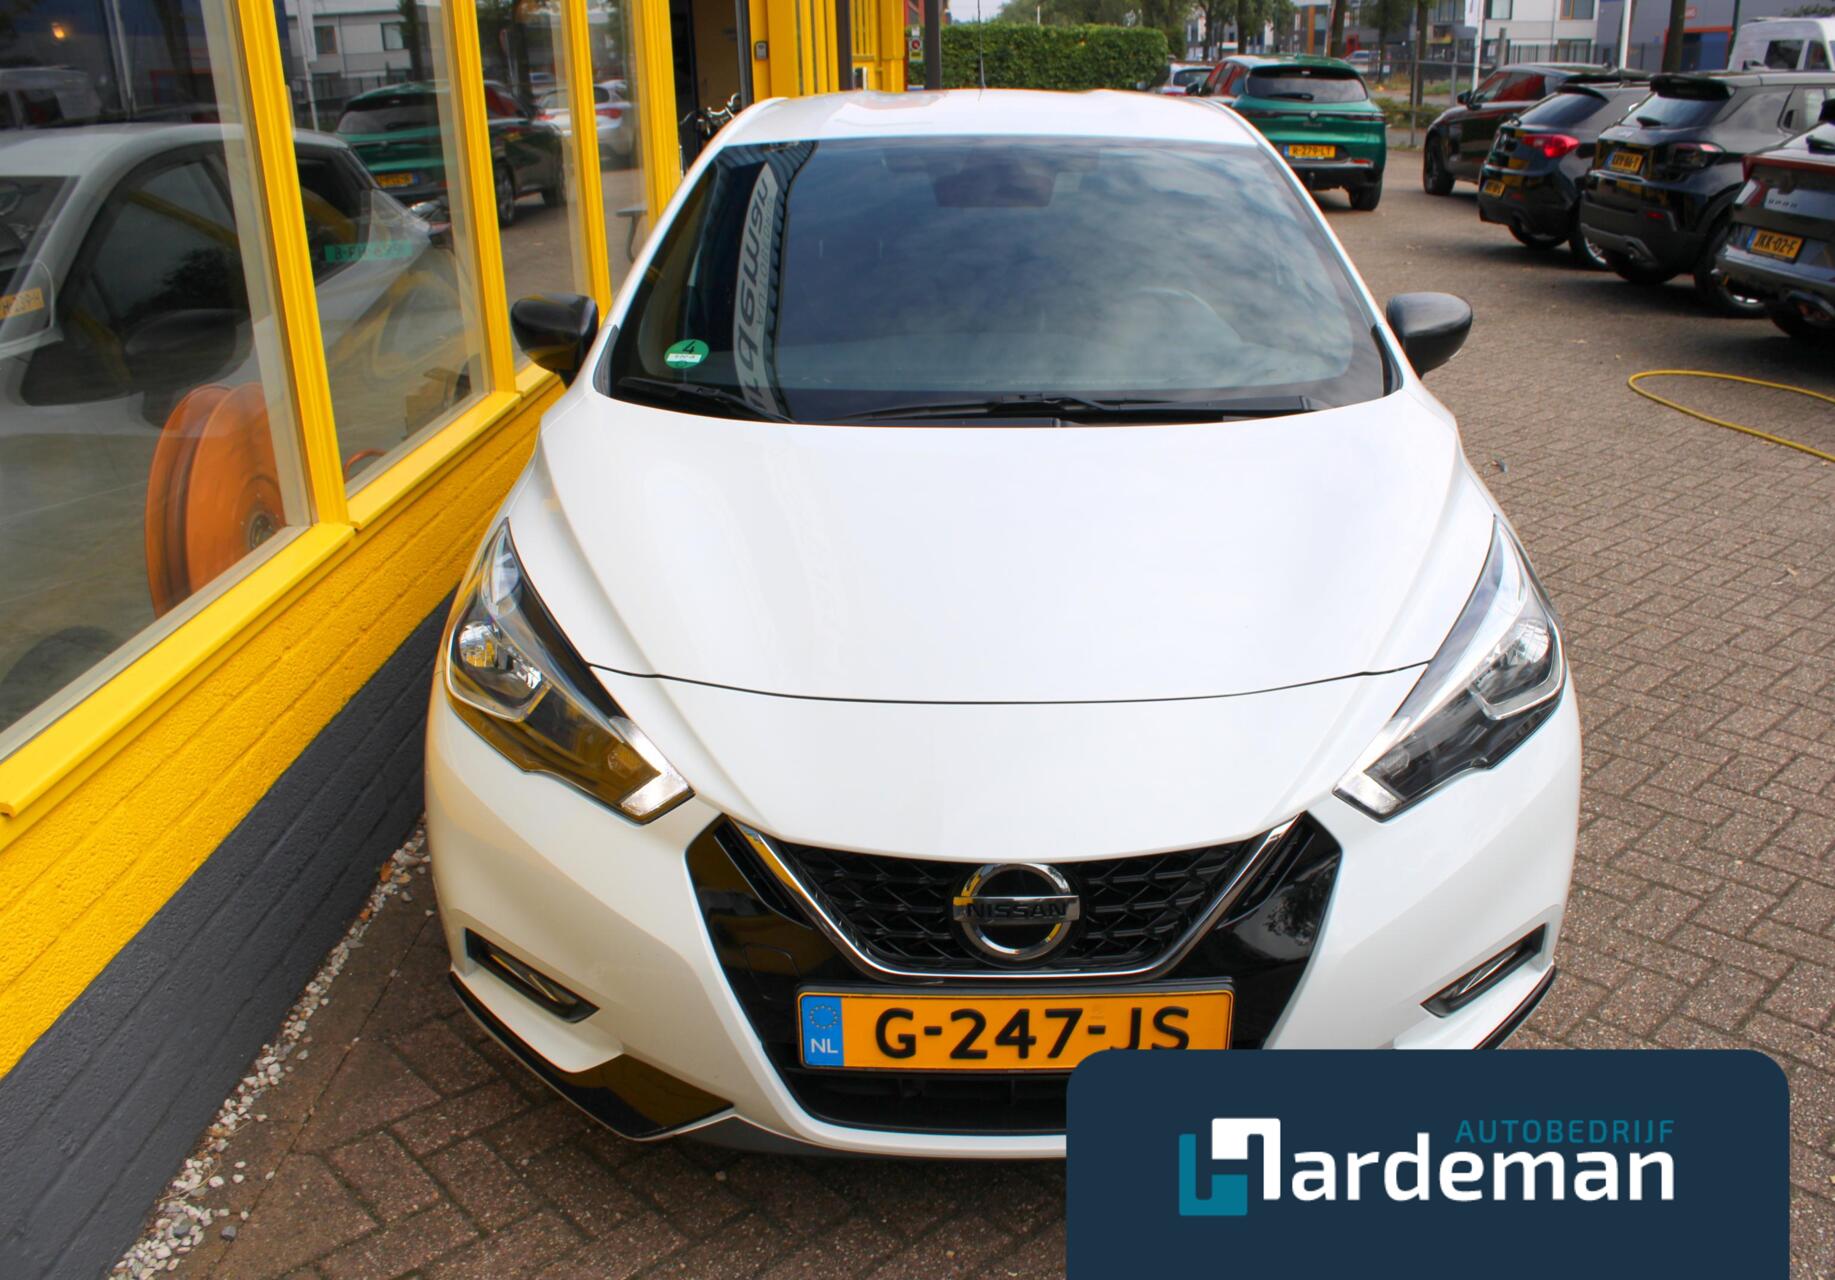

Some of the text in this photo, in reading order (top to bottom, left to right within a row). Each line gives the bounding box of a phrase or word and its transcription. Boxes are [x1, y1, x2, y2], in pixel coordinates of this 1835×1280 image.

[682, 339, 696, 354] 4
[966, 902, 1068, 919] NISSAN
[810, 1006, 1190, 1059] NL G-247-JS
